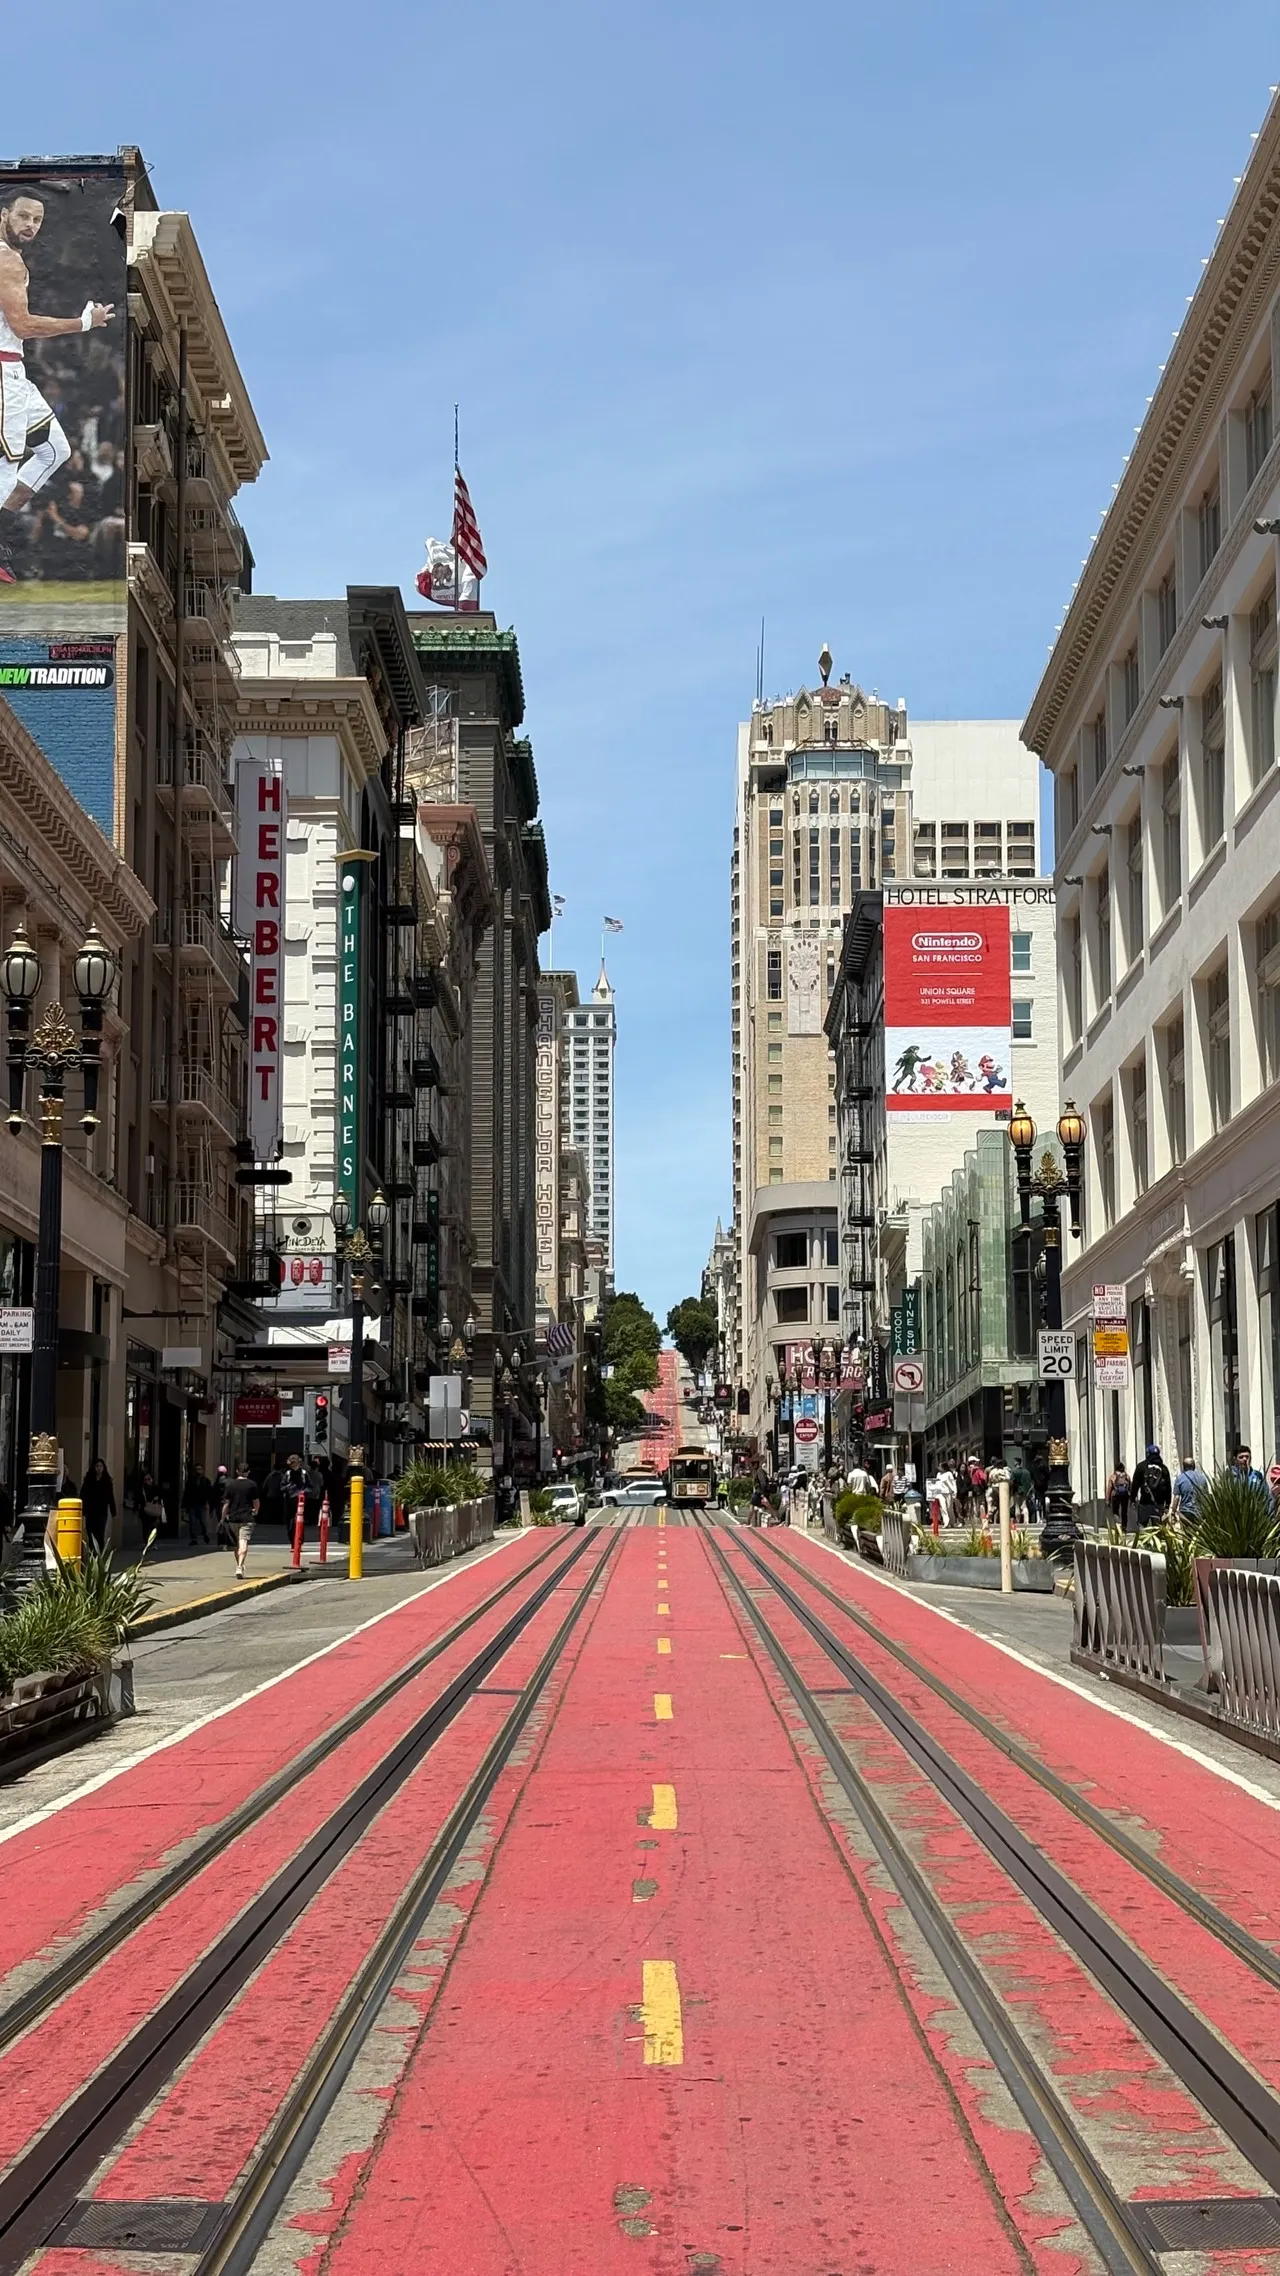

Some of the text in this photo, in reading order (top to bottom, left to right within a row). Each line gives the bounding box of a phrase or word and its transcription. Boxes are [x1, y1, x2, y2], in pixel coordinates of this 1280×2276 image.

[888, 887, 948, 905] HOTEL
[254, 776, 280, 1100] HERBERT
[918, 936, 977, 947] Nintendo
[912, 954, 982, 962] SAN FRANCISCO
[919, 987, 976, 995] UNION SQUARE
[343, 905, 355, 1176] THE BARNES
[536, 998, 554, 1271] CHANCELLOR HOTEL
[905, 1293, 915, 1326] WINE
[1041, 1336, 1073, 1344] SPEED
[1044, 1346, 1069, 1354] LIMIT
[1043, 1356, 1072, 1374] 20
